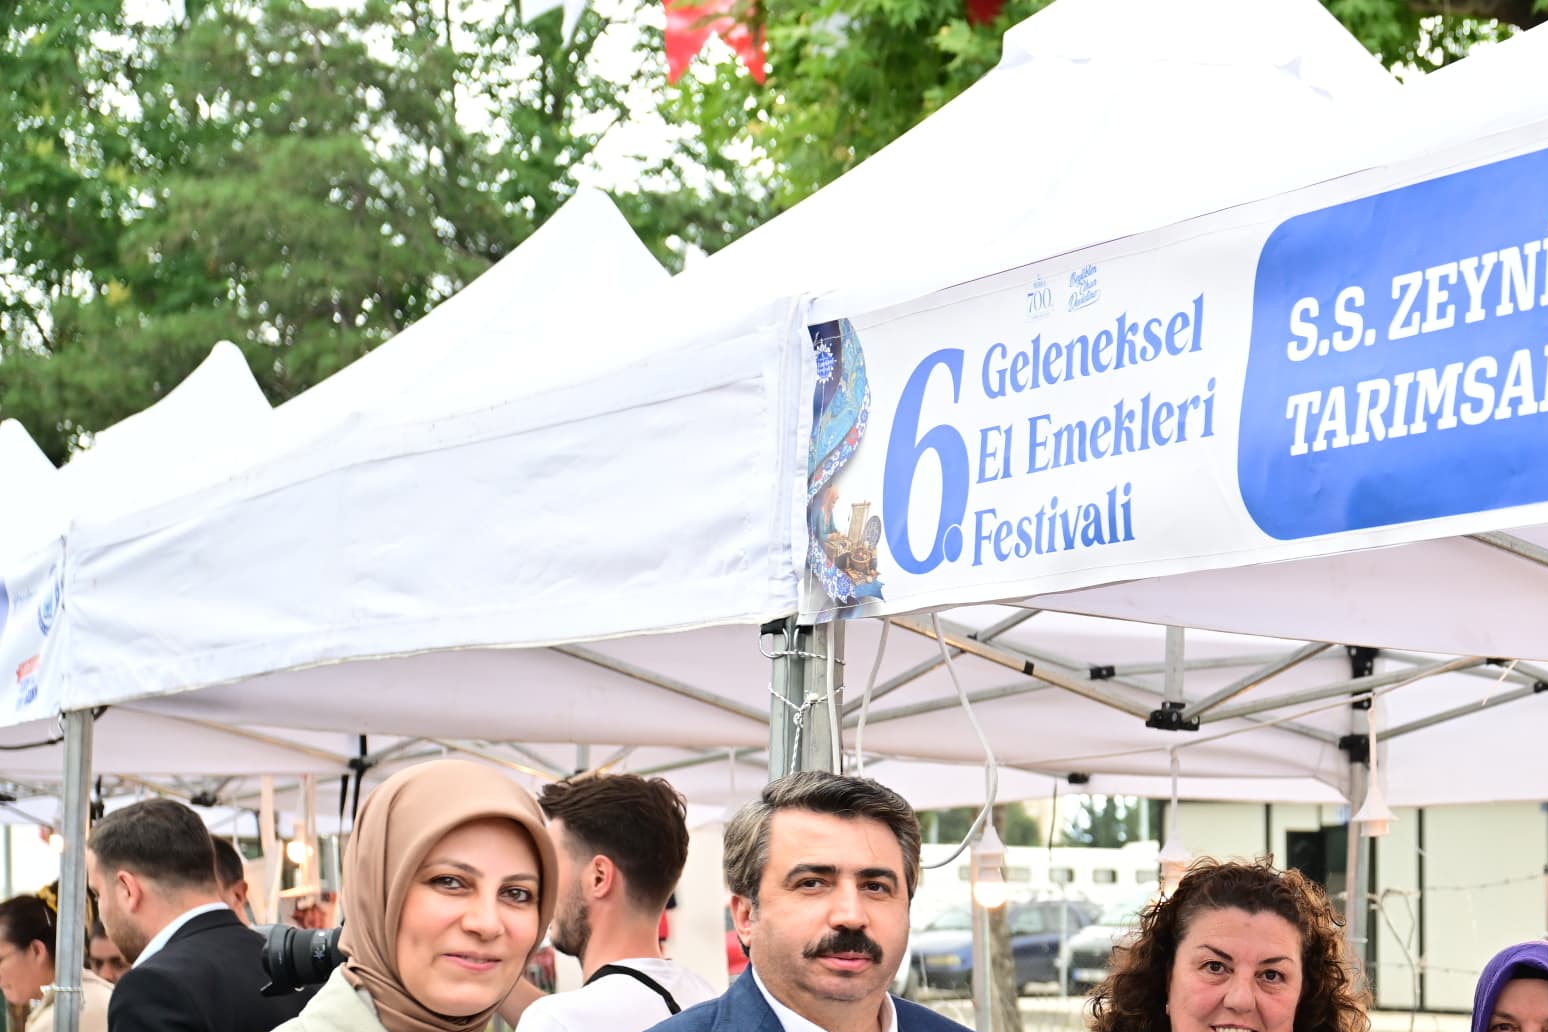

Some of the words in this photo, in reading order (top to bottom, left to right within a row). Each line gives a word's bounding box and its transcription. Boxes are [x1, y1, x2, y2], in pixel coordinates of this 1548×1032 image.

[981, 292, 1205, 400] Geleneksel
[1286, 285, 1376, 362] S.S.
[976, 423, 1012, 485] El
[1027, 376, 1216, 475] Emekleri
[972, 481, 1136, 566] Festivali
